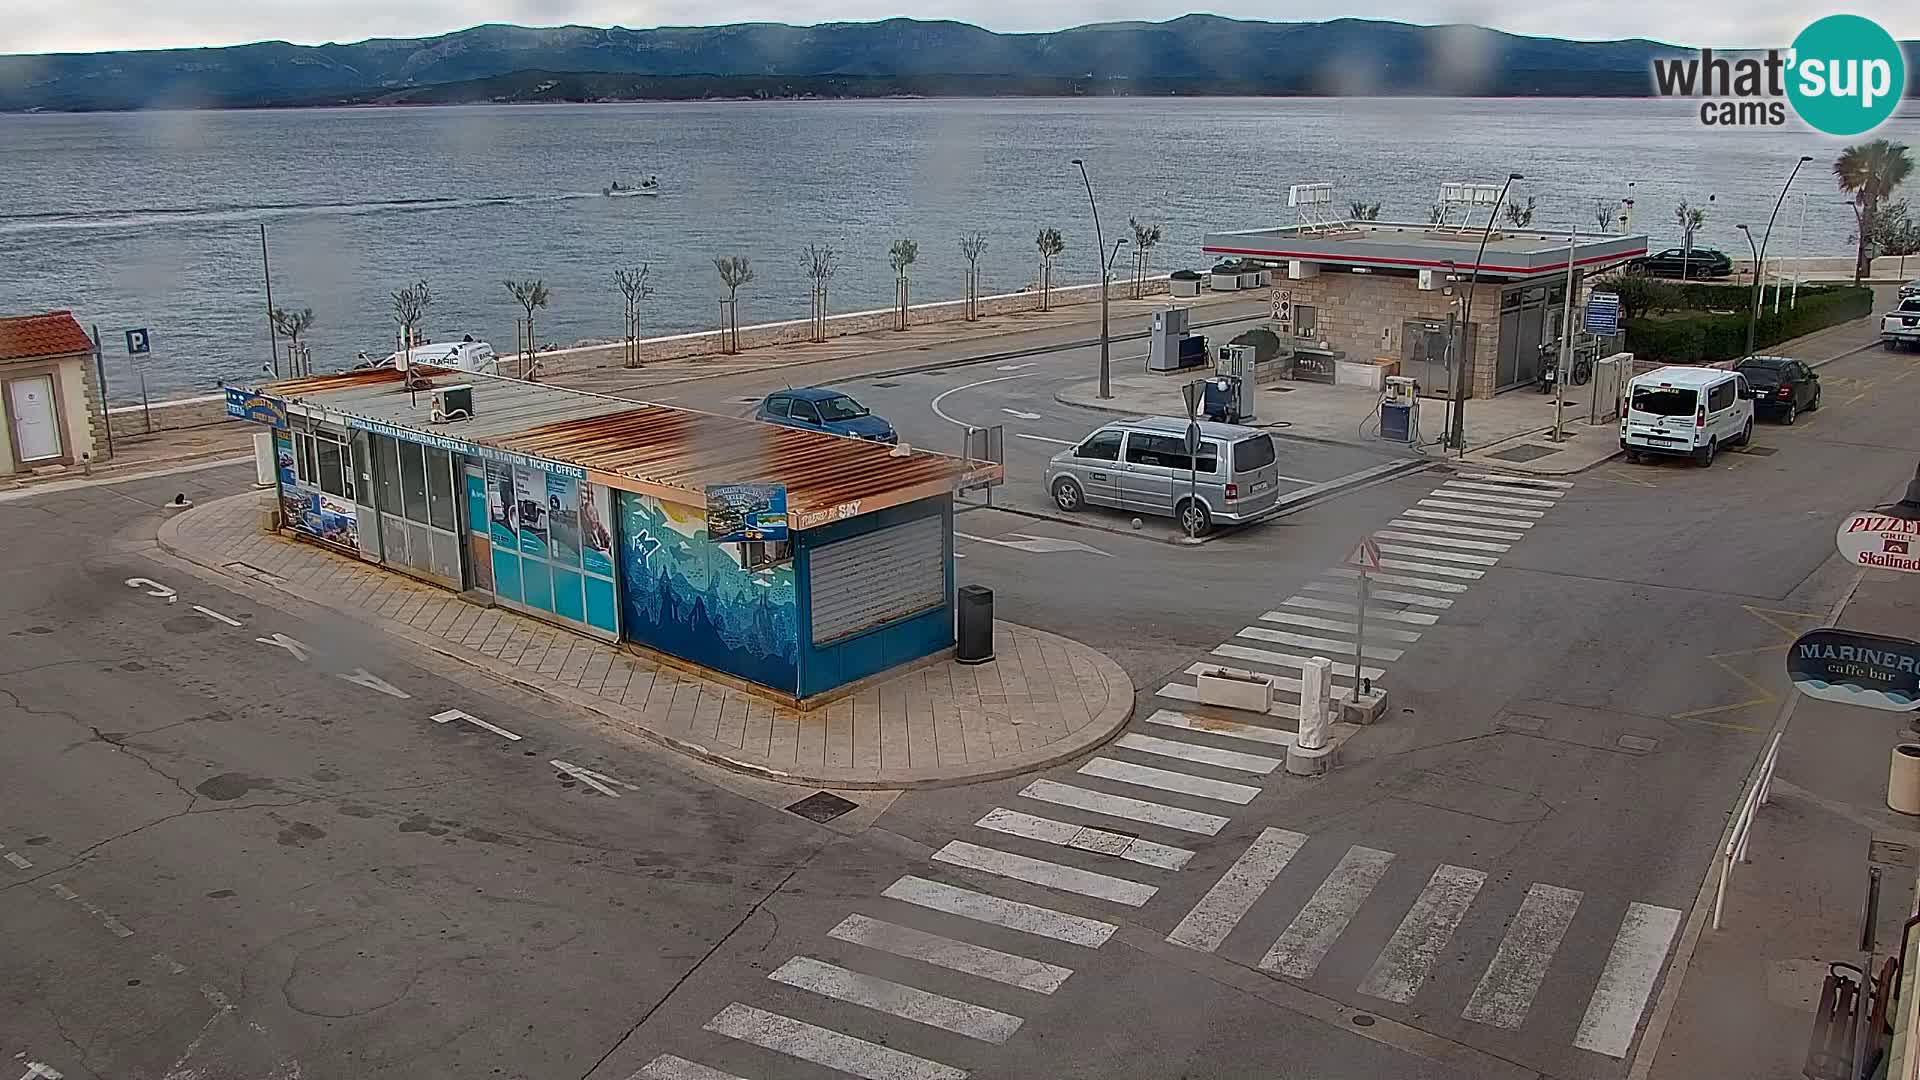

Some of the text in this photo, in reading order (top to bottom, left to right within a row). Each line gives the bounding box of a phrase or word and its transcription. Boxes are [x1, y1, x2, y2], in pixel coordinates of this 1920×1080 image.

[131, 332, 144, 351] P
[437, 437, 469, 453] POSTAJA
[479, 447, 493, 459] BUS
[494, 450, 527, 465] STATION
[529, 458, 555, 472] TICKET
[556, 463, 583, 479] OFFICE
[1847, 516, 1920, 535] PIZZE
[1880, 532, 1916, 543] GRILL
[1828, 663, 1896, 681] caffe bar
